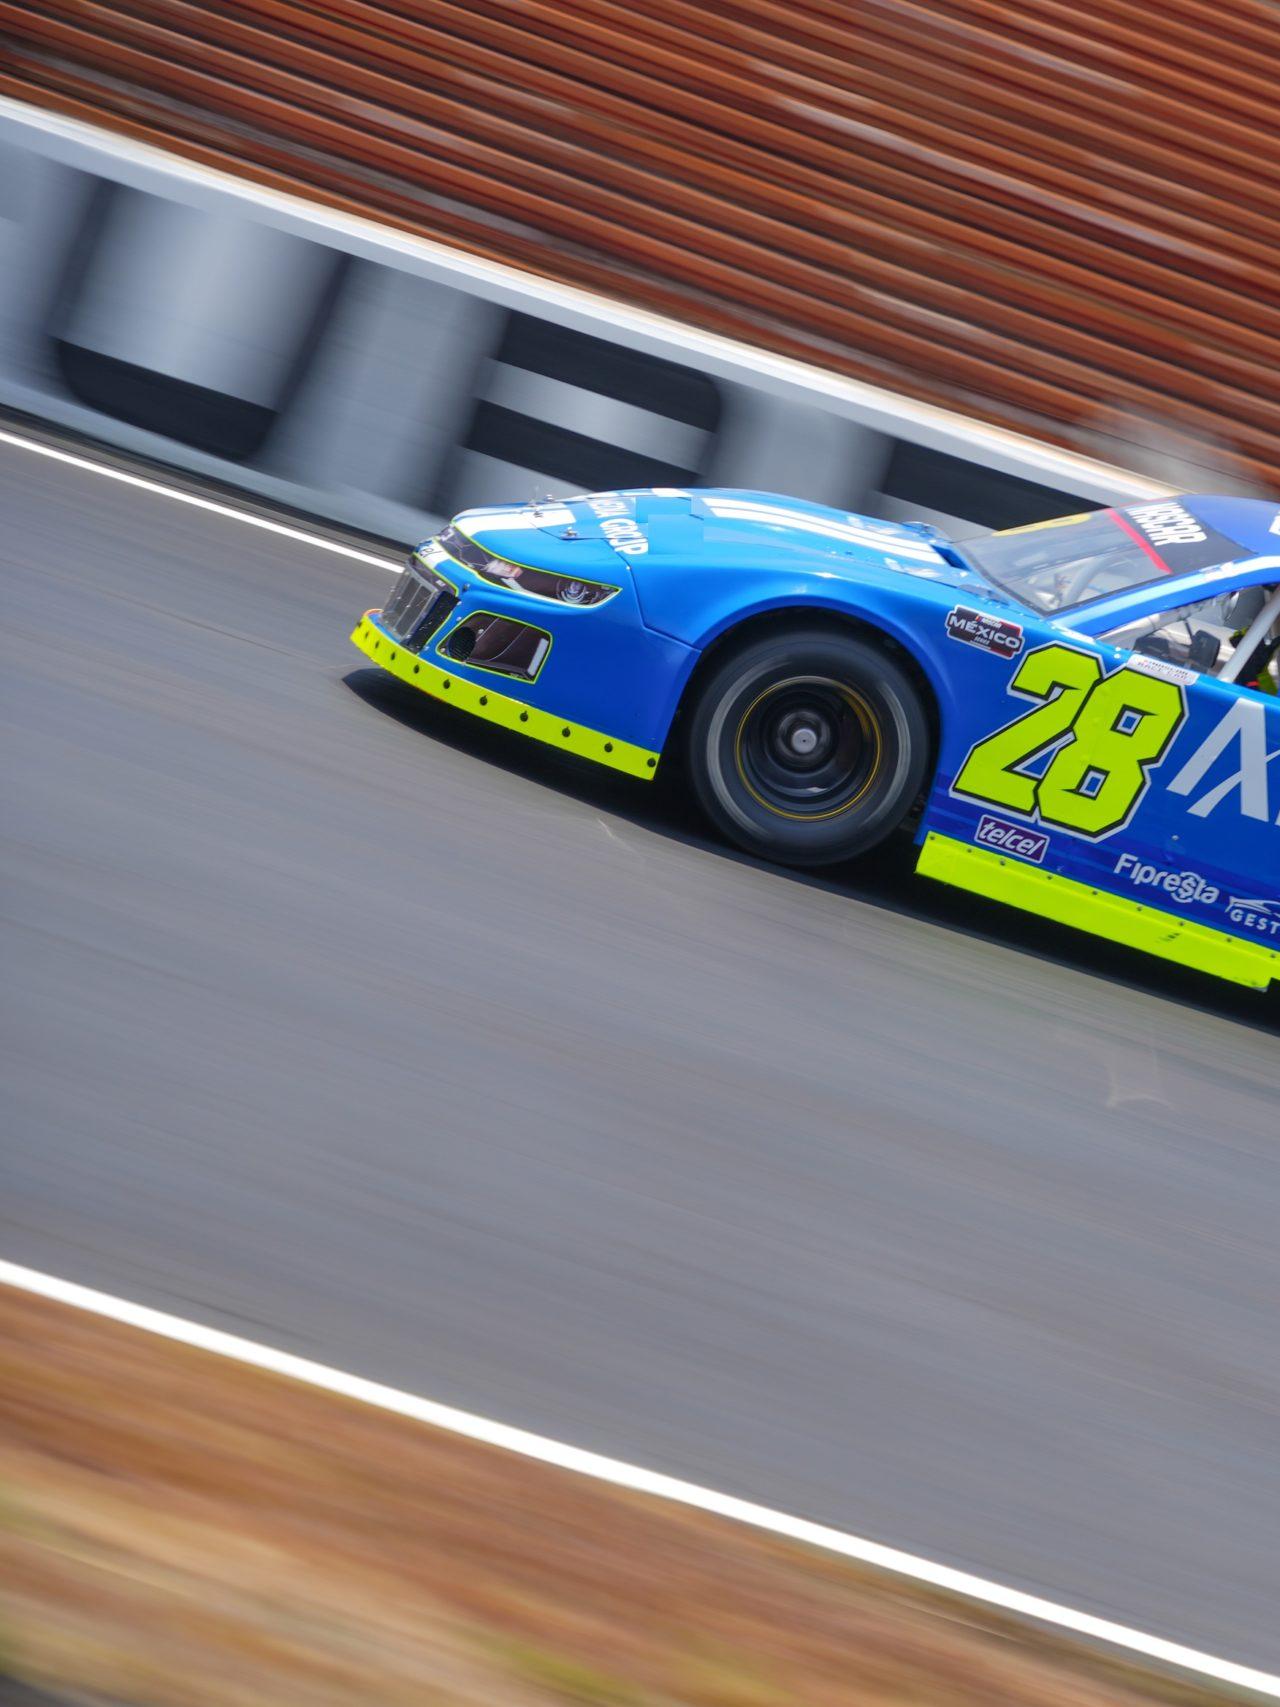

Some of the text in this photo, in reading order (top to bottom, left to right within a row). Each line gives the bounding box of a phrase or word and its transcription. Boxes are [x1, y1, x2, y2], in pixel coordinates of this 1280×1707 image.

[1124, 502, 1207, 546] NASCAR
[949, 615, 1021, 650] MÉXICO
[949, 640, 1188, 843] 28
[978, 822, 1045, 857] telcel
